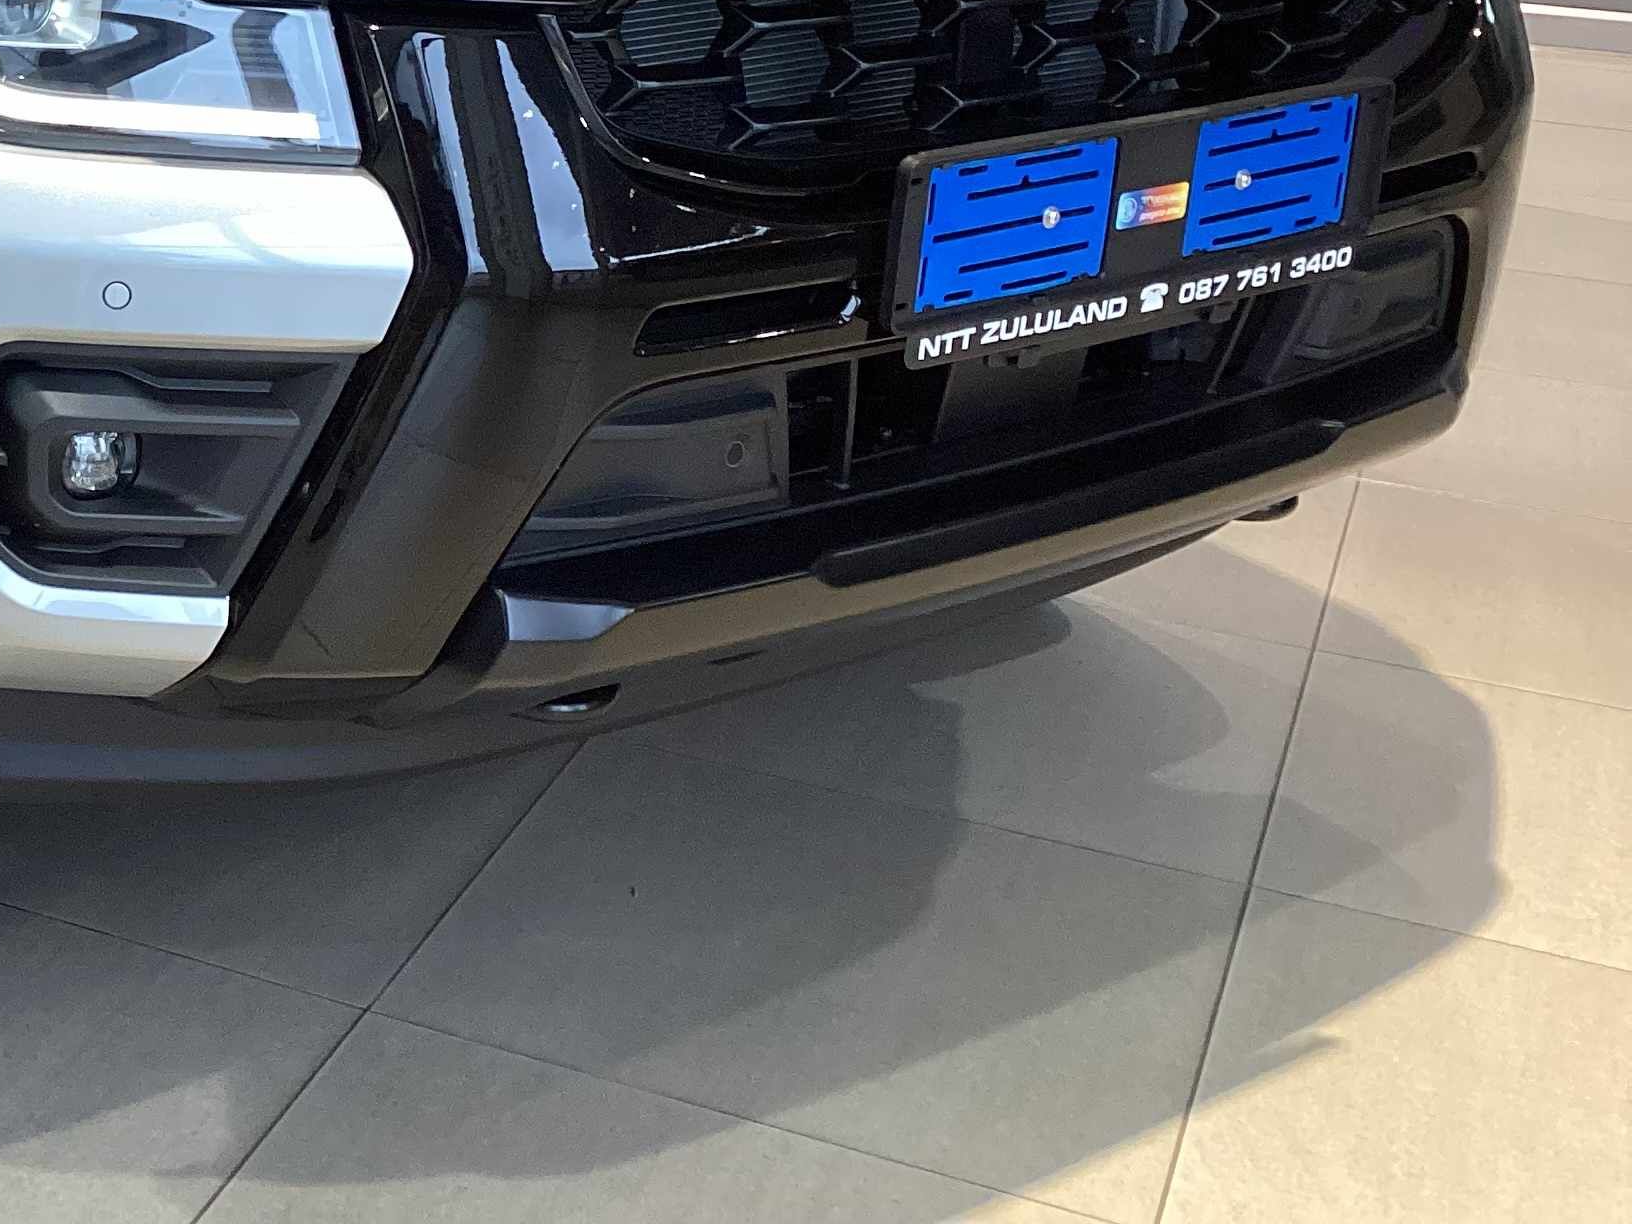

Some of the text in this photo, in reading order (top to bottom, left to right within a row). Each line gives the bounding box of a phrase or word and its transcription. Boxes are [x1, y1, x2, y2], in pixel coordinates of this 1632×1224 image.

[917, 245, 1353, 361] NTT ZULULAND 087 761 3400
